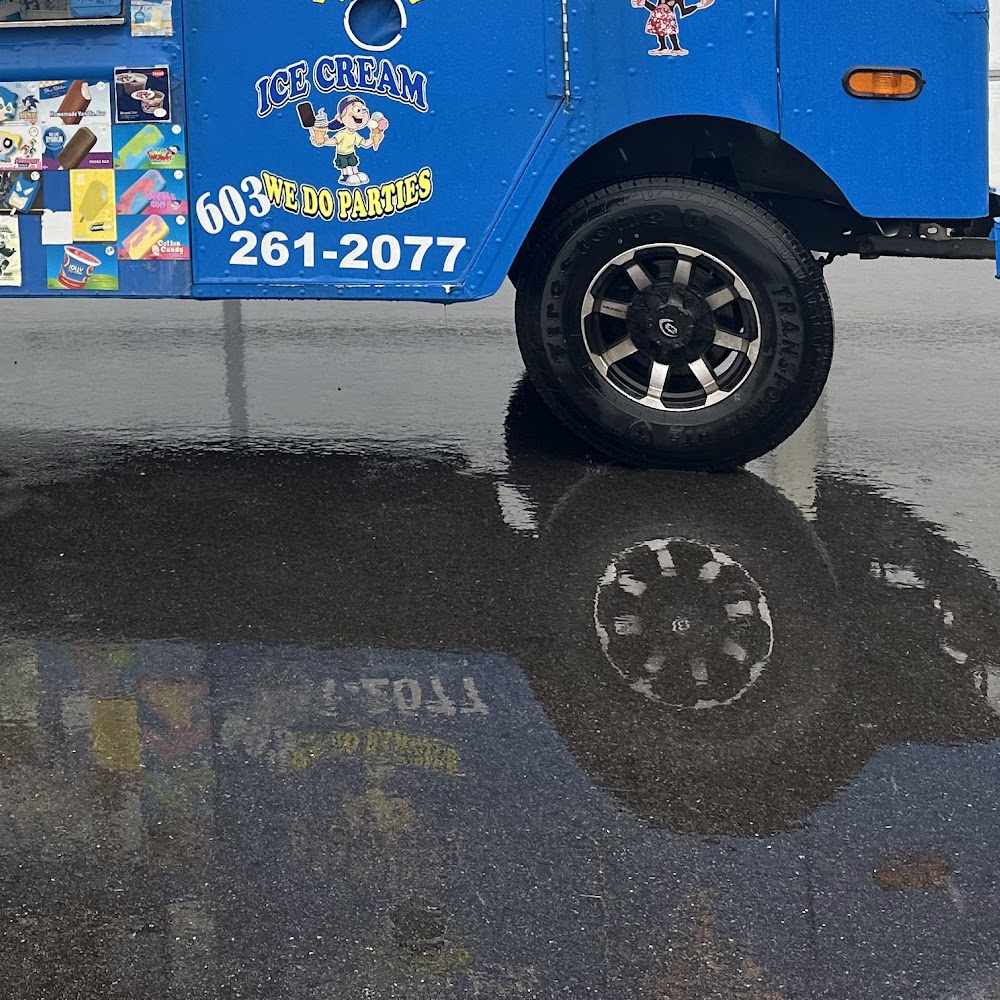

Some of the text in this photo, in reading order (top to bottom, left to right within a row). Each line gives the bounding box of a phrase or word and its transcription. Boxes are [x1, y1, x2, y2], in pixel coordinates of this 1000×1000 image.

[256, 54, 429, 118] ICE CREAM
[50, 110, 77, 118] Homemade
[195, 175, 271, 235] 603
[260, 166, 434, 221] WE DO PARTIES
[157, 239, 182, 248] Cotton
[160, 246, 184, 255] Candy
[228, 229, 468, 273] 261-2077
[68, 264, 84, 273] JOLLY
